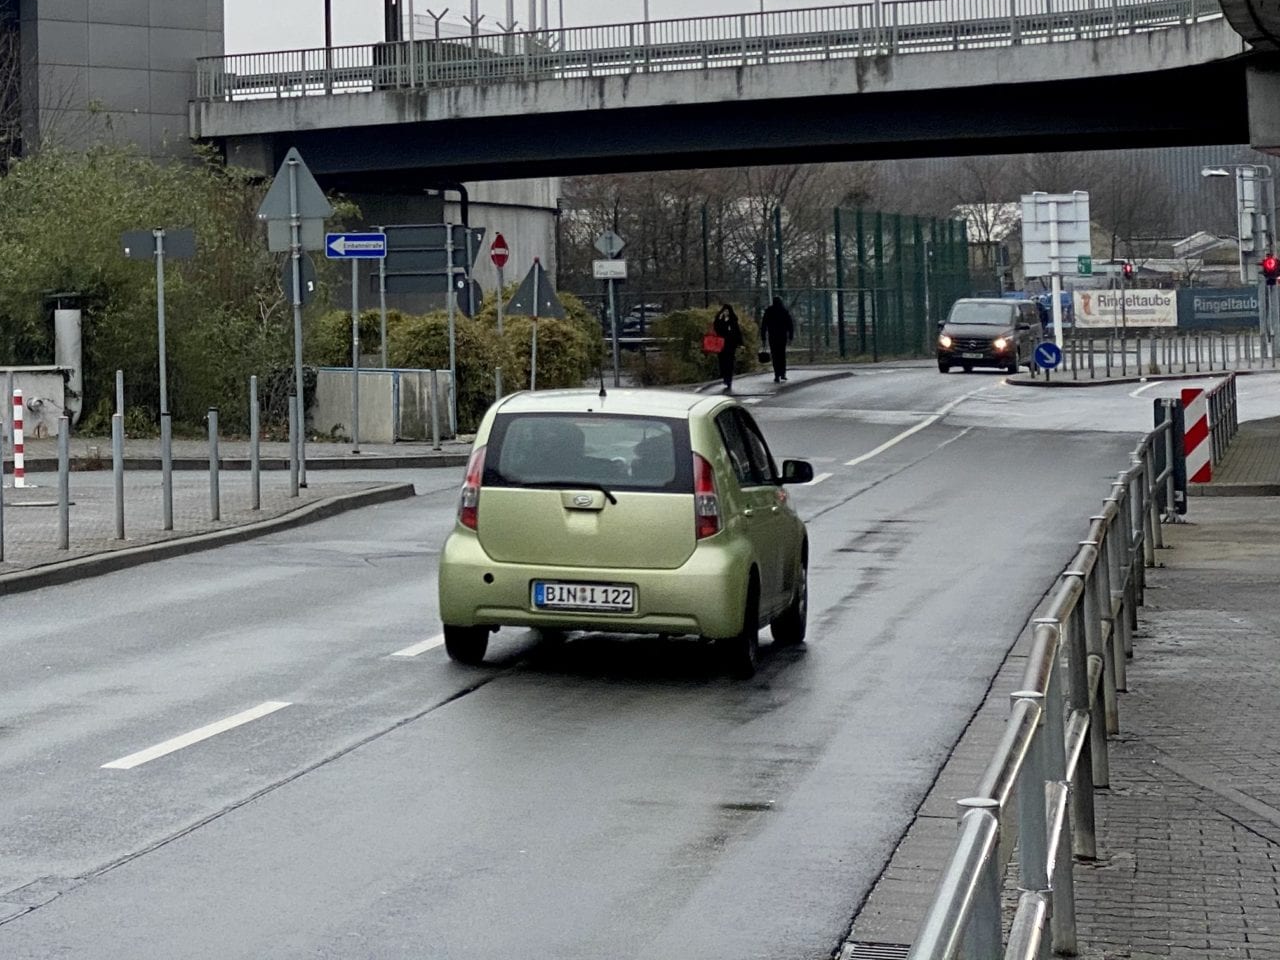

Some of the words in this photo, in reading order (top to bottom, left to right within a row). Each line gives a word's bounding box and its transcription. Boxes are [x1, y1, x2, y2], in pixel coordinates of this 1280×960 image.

[1098, 294, 1171, 309] Ringeltaube
[1193, 296, 1258, 312] Ringeltaub
[546, 586, 577, 602] BIN
[589, 588, 597, 603] I
[601, 588, 631, 605] 122
